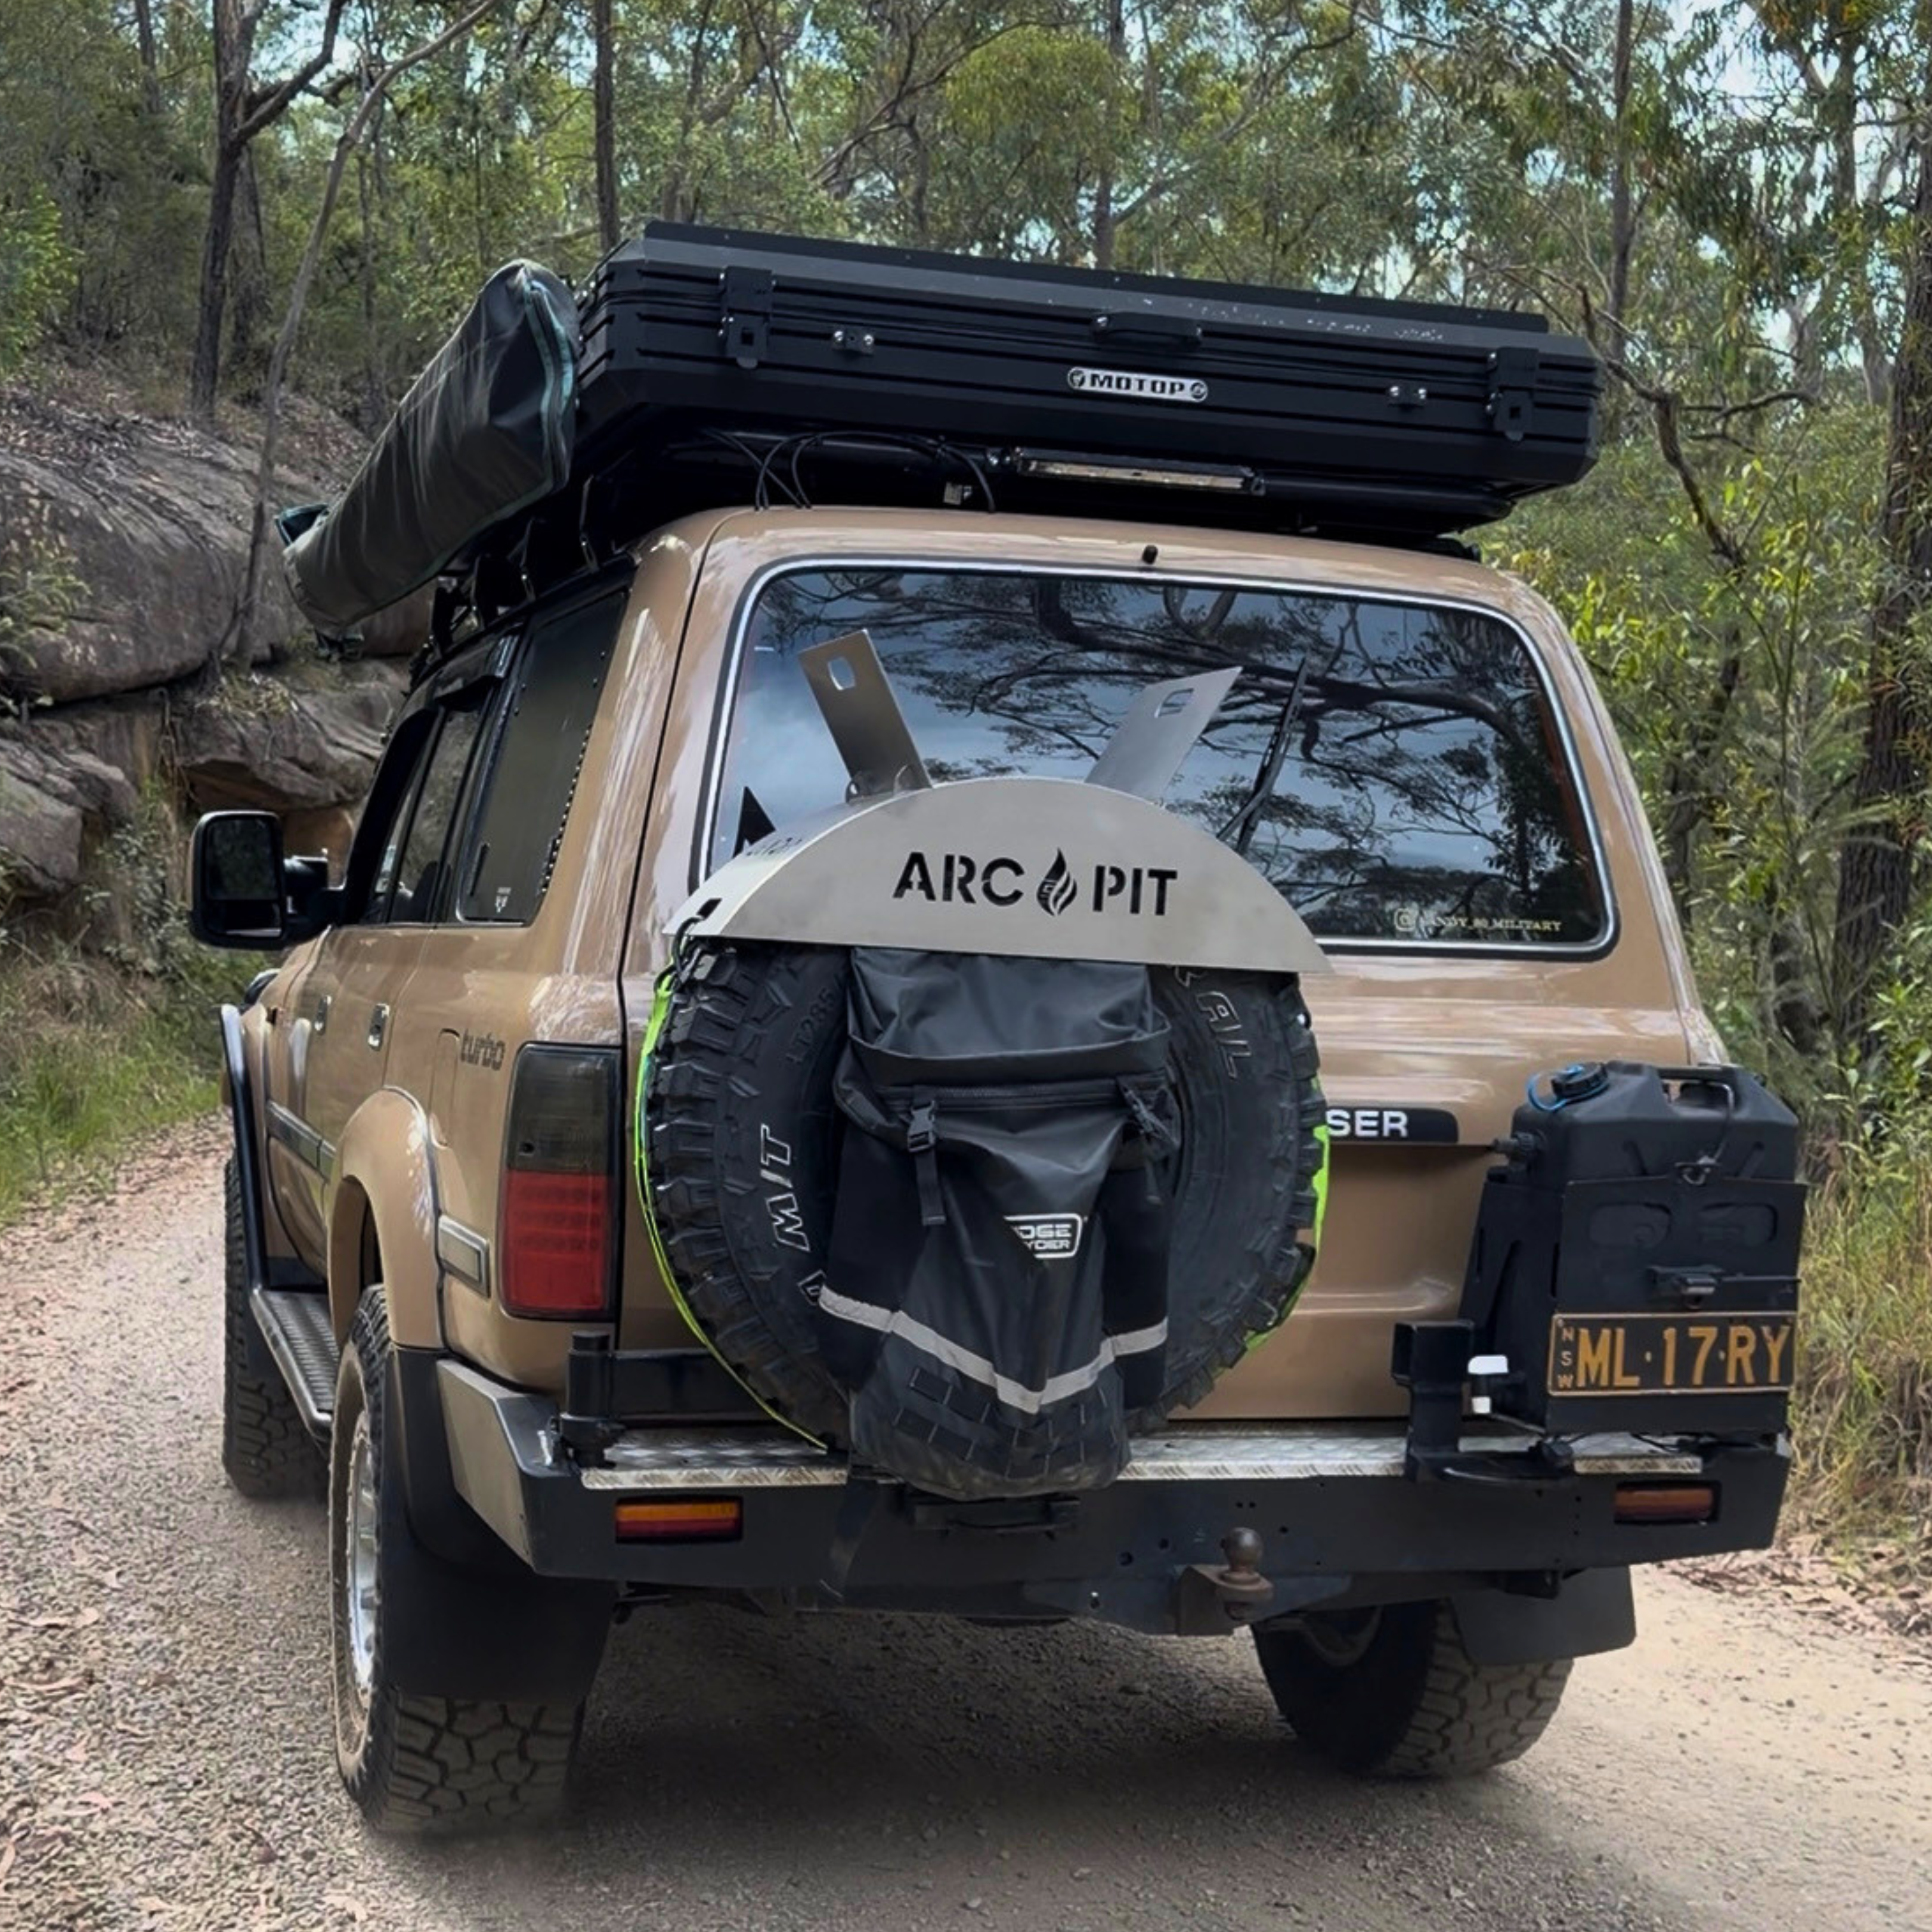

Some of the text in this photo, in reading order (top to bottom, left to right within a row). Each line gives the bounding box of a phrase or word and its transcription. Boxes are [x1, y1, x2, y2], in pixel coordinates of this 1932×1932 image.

[1090, 373, 1185, 395] MOTOP
[893, 852, 1178, 916] ARC PIT
[461, 1028, 506, 1071] turbo
[1326, 1109, 1408, 1137] SER
[1012, 1224, 1072, 1239] DGE
